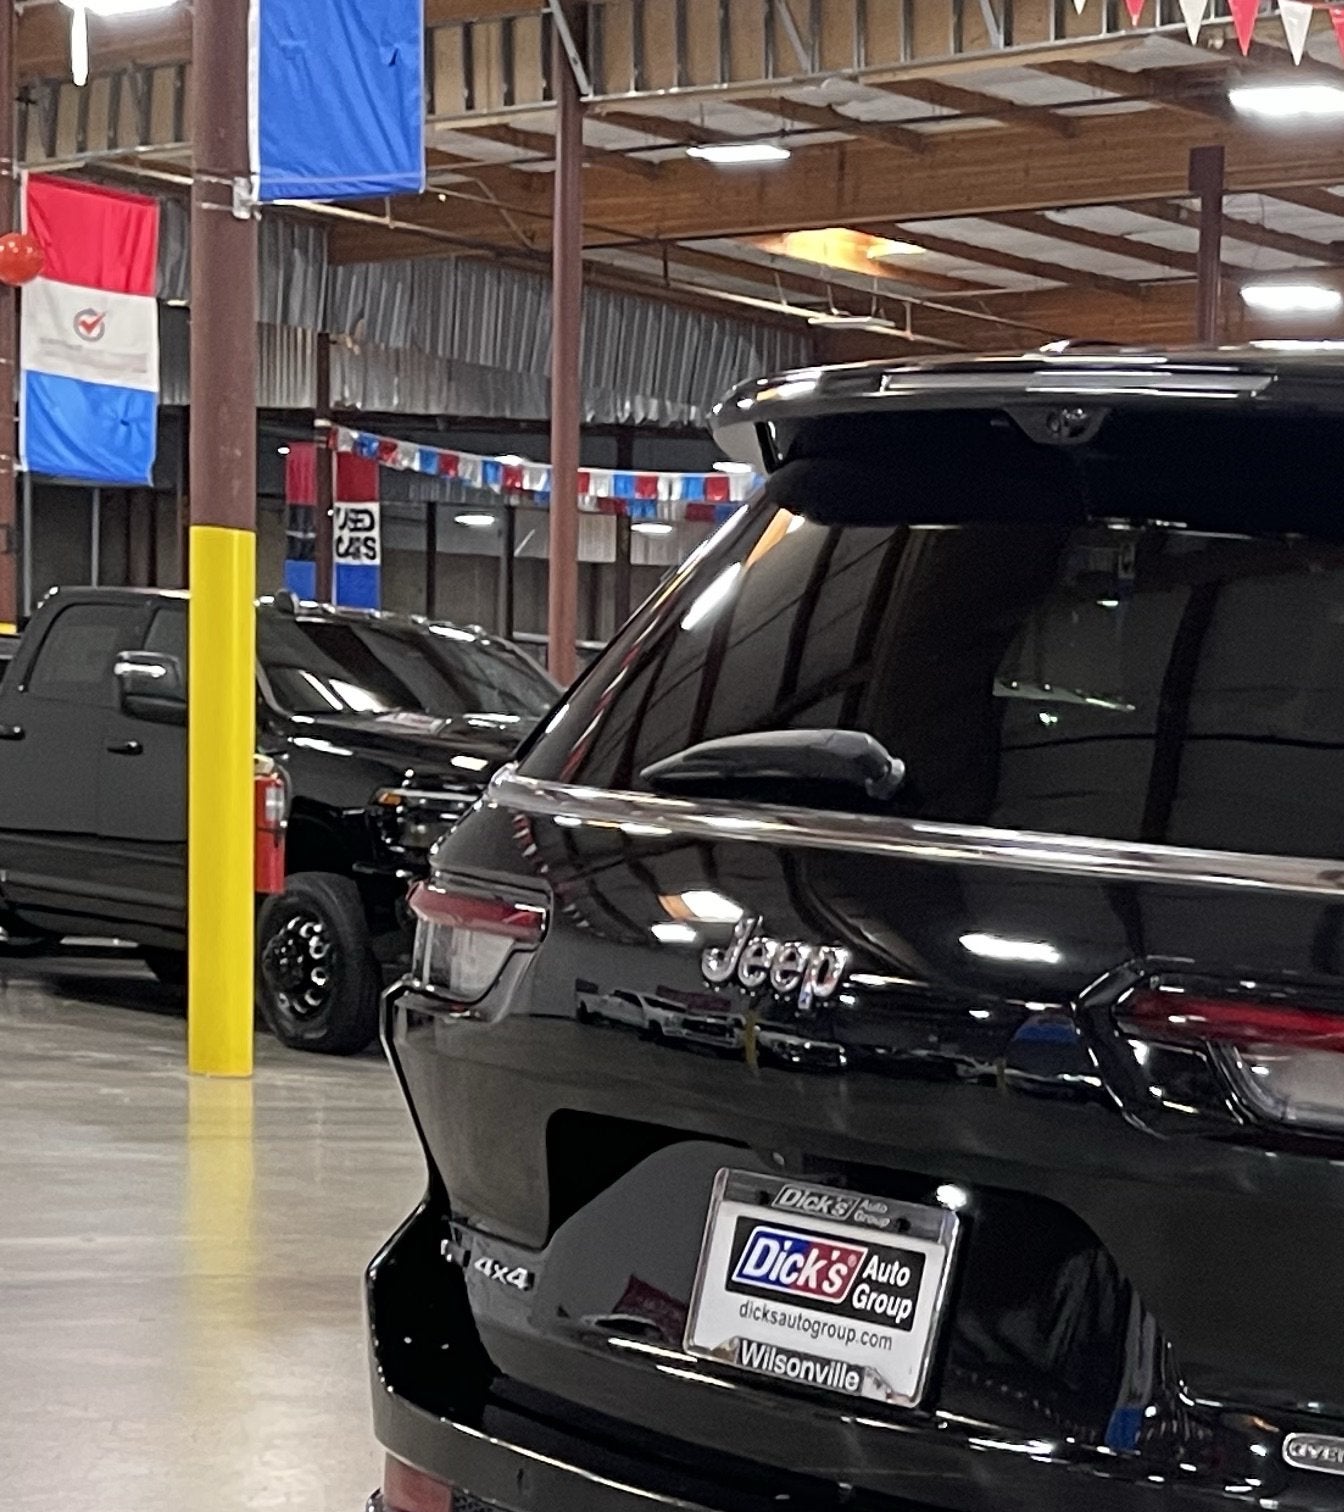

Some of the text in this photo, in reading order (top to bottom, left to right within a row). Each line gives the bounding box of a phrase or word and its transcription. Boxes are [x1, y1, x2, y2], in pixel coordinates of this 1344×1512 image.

[701, 915, 849, 1010] Jeep
[778, 1186, 888, 1217] Dick's Auto
[474, 1256, 529, 1290] 4x4
[743, 1237, 911, 1294] Dick's Auto
[739, 1299, 893, 1351] dicksautogroup.com
[852, 1284, 913, 1324] Group
[740, 1339, 861, 1392] Wilsonville
